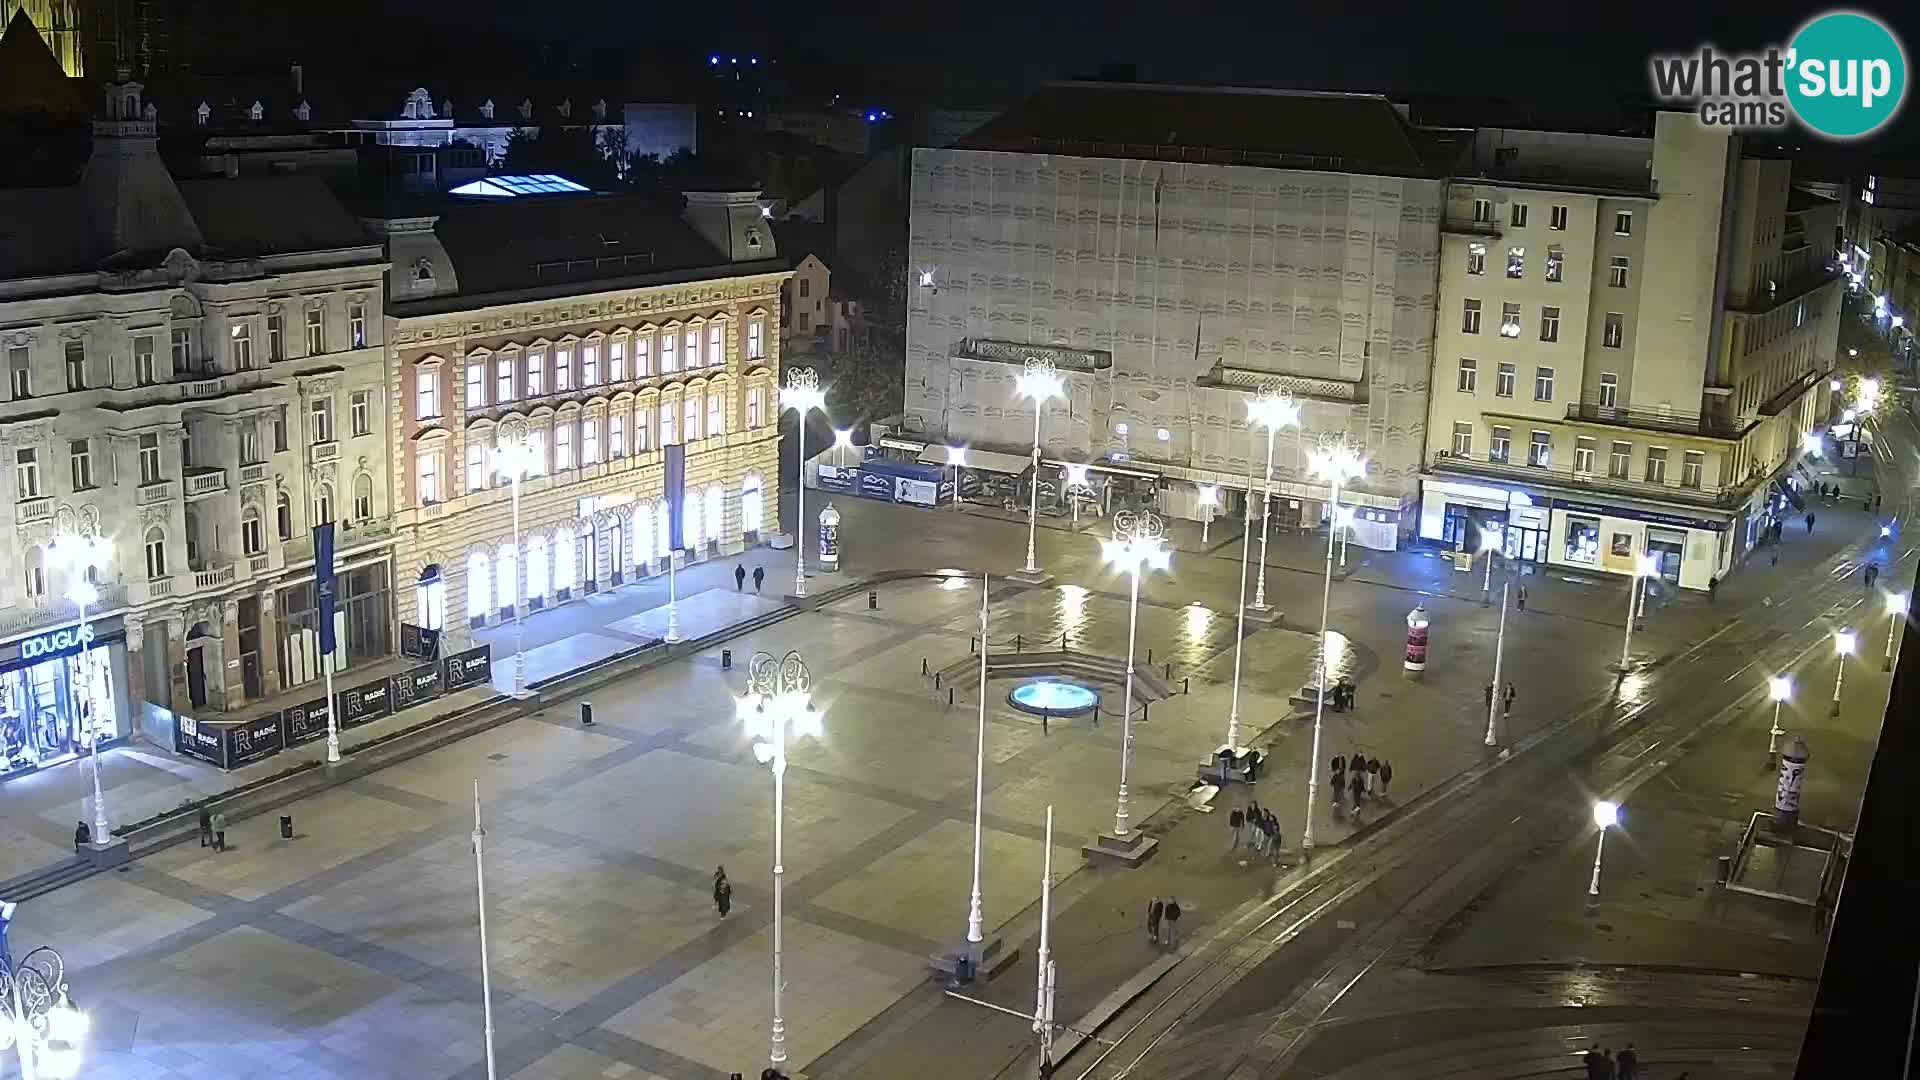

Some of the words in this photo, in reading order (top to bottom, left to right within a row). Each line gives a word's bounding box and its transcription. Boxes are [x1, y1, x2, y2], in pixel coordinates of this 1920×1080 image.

[449, 658, 464, 682] R
[347, 691, 363, 715] R
[292, 709, 307, 734] R
[235, 730, 252, 753] R
